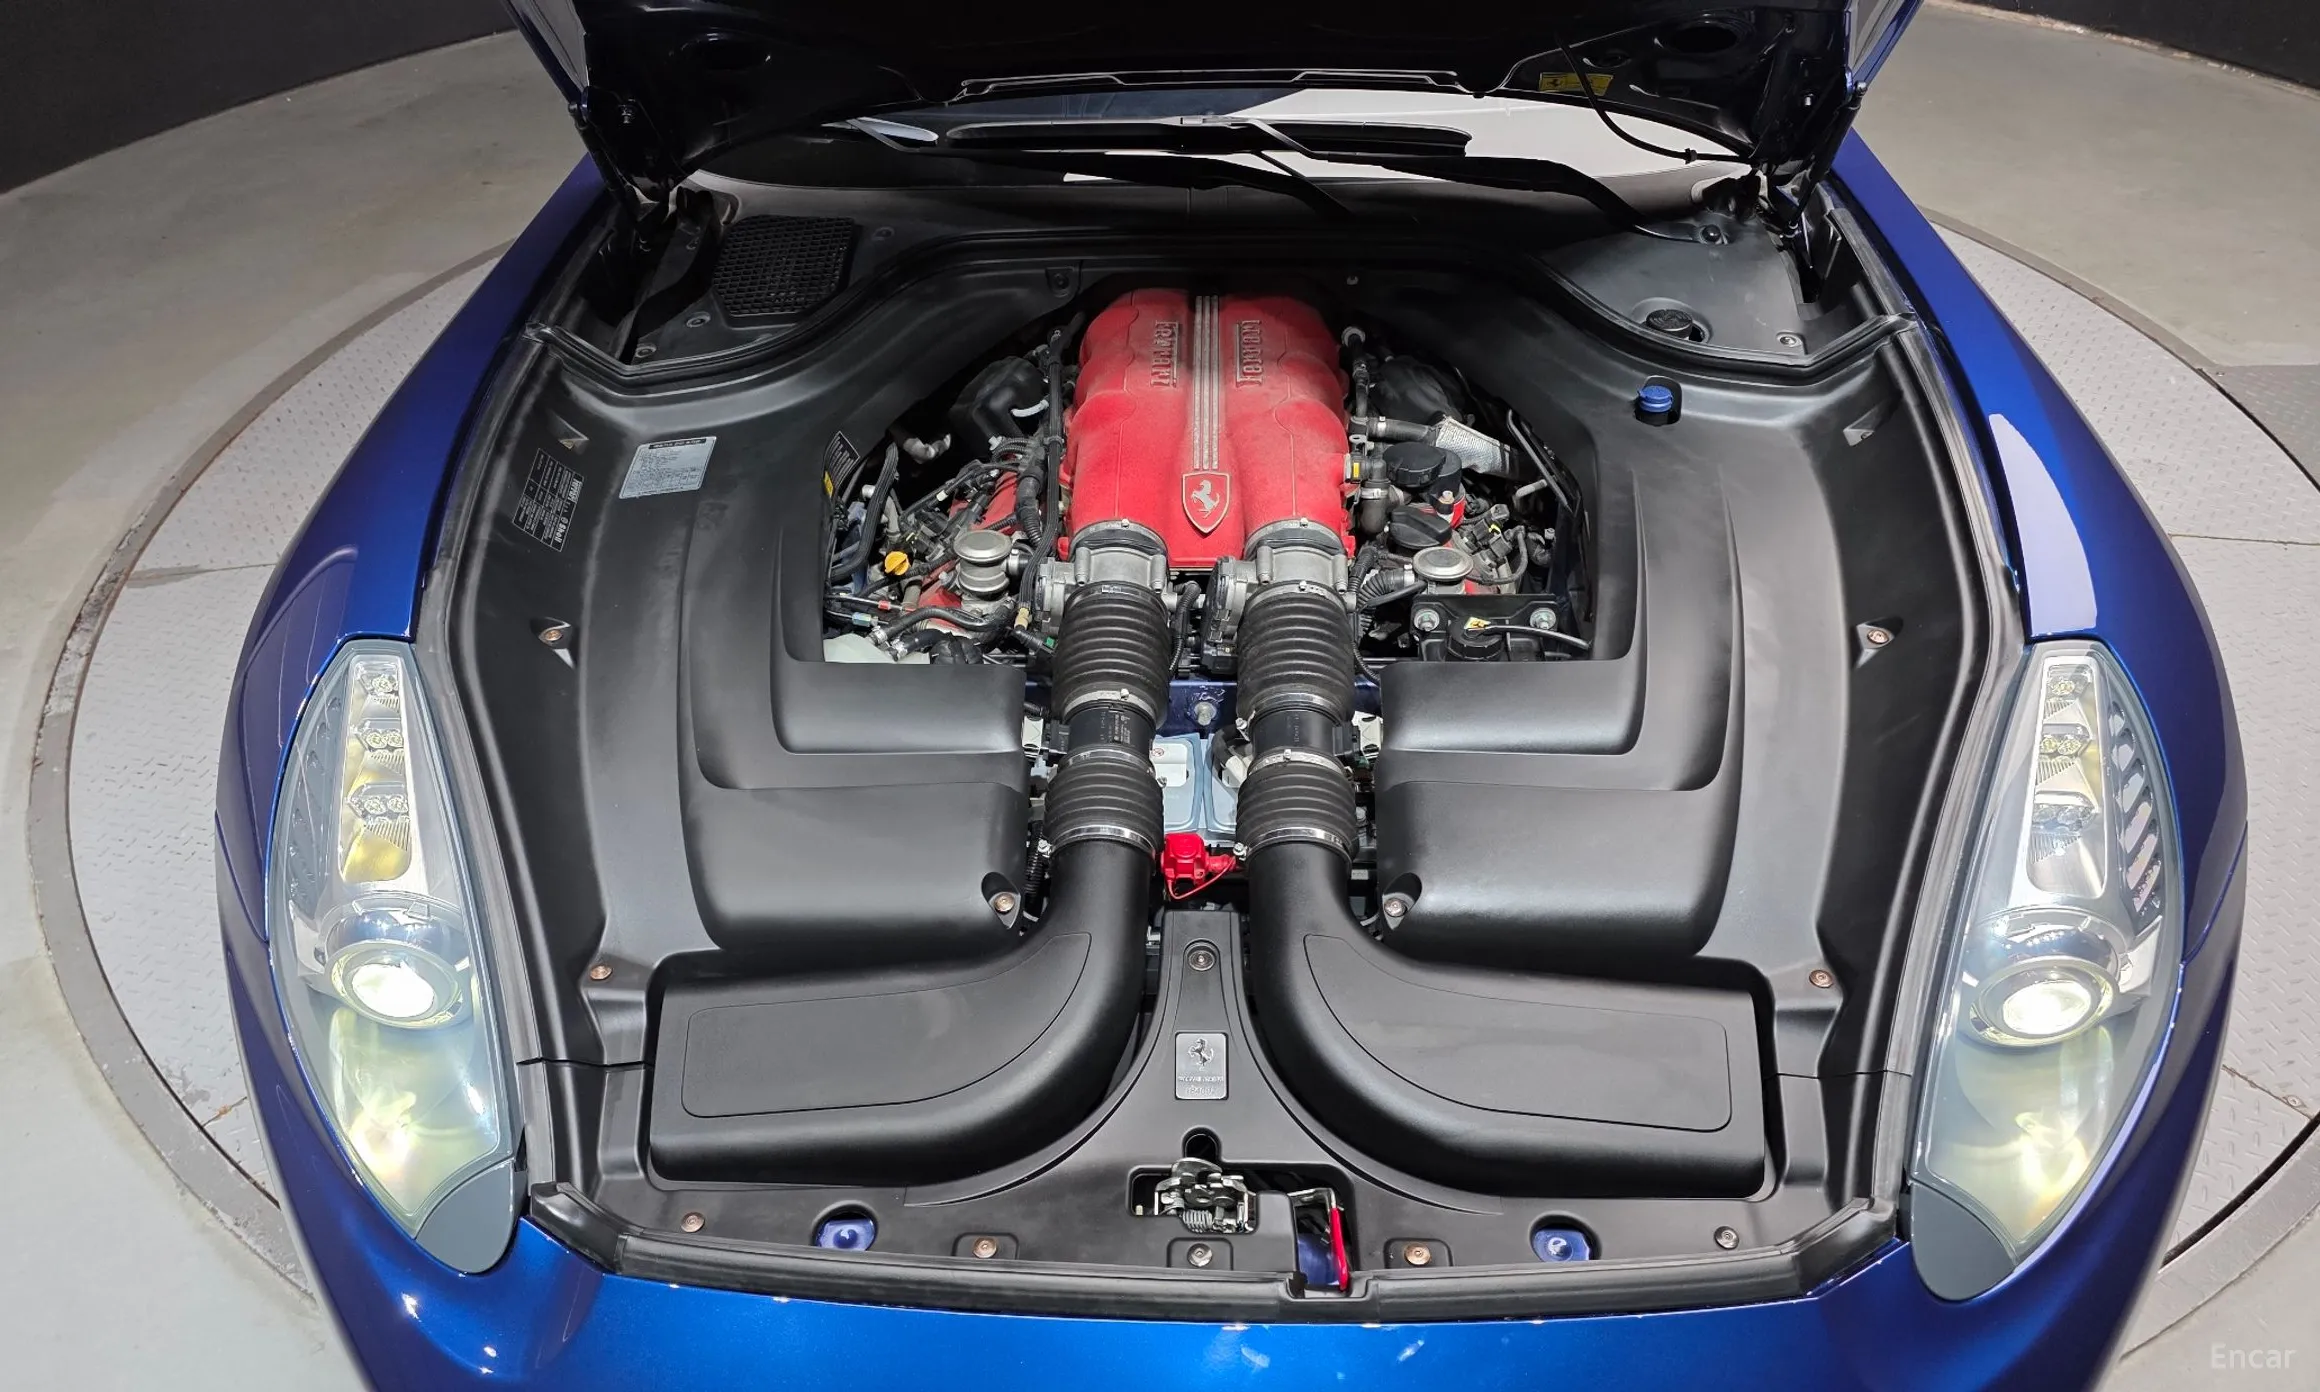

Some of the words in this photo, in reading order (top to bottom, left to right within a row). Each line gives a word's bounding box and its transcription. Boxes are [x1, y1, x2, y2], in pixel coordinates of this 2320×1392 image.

[1150, 320, 1178, 387] Ferrari
[1236, 320, 1262, 387] Ferrari
[554, 523, 566, 543] Shell
